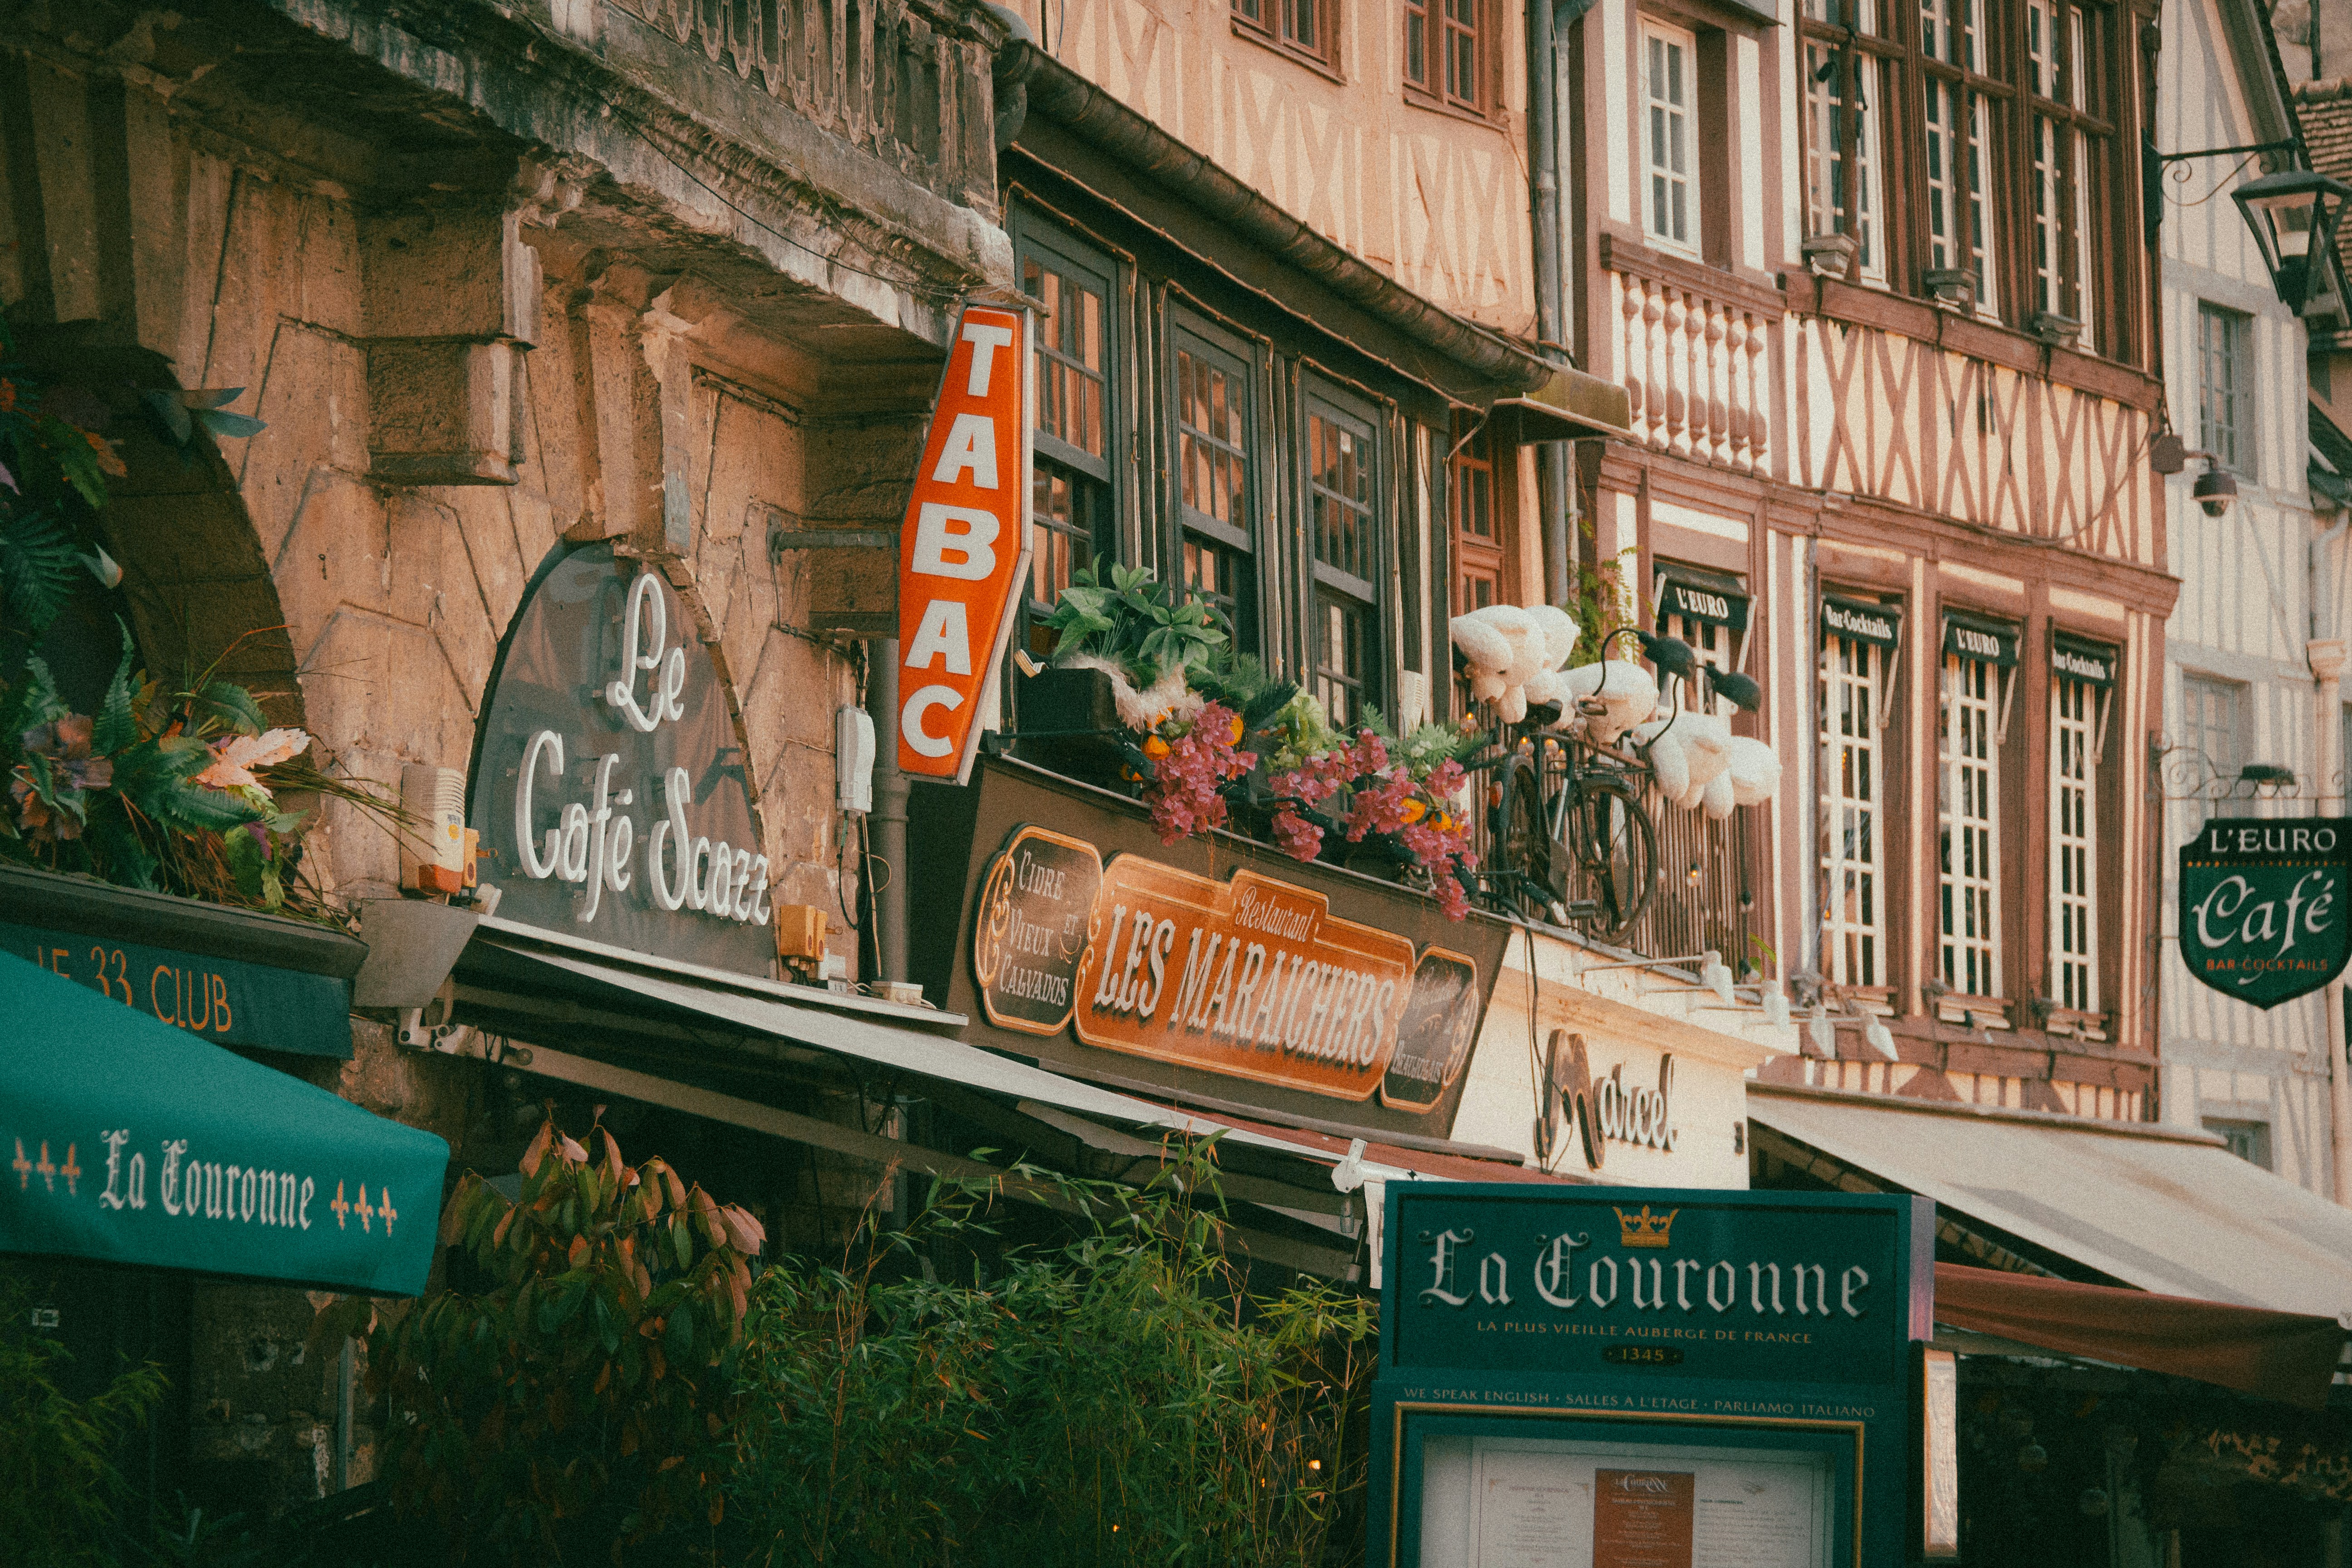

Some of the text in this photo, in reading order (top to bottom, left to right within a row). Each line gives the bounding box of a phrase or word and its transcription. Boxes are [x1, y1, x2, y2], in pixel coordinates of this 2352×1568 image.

[901, 322, 1013, 758] TABAC
[1675, 587, 1729, 619] L'EURO
[606, 573, 685, 732] Le
[1955, 627, 2000, 657] L'EURO
[515, 730, 633, 922] Café
[2210, 828, 2337, 853] L'EURO
[1019, 848, 1065, 901] CIDRE
[1010, 908, 1054, 957] VIEUX
[1063, 913, 1079, 936] ET
[1235, 886, 1316, 942] Restaurant
[2191, 870, 2334, 985] Café
[91, 946, 132, 1007] 33
[151, 965, 232, 1032] CLUB
[1000, 951, 1069, 1007] CALVADOS
[1094, 904, 1175, 1018] LES
[1171, 926, 1396, 1066] MARAICHERS
[2206, 958, 2328, 971] BAR COCKTAILS
[1534, 1028, 1678, 1169] Marcel
[98, 1128, 315, 1230] La Couronne
[1418, 1228, 1870, 1318] La Couronne
[1477, 1321, 1812, 1344] LA PLUS VIEILLE AUBERGE DE FRANCE
[1622, 1348, 1665, 1362] 1345
[1404, 1387, 1876, 1418] WE SPEAK ENGLISH SALLES A L'ETAGE PARLIAMO ITALIANO
